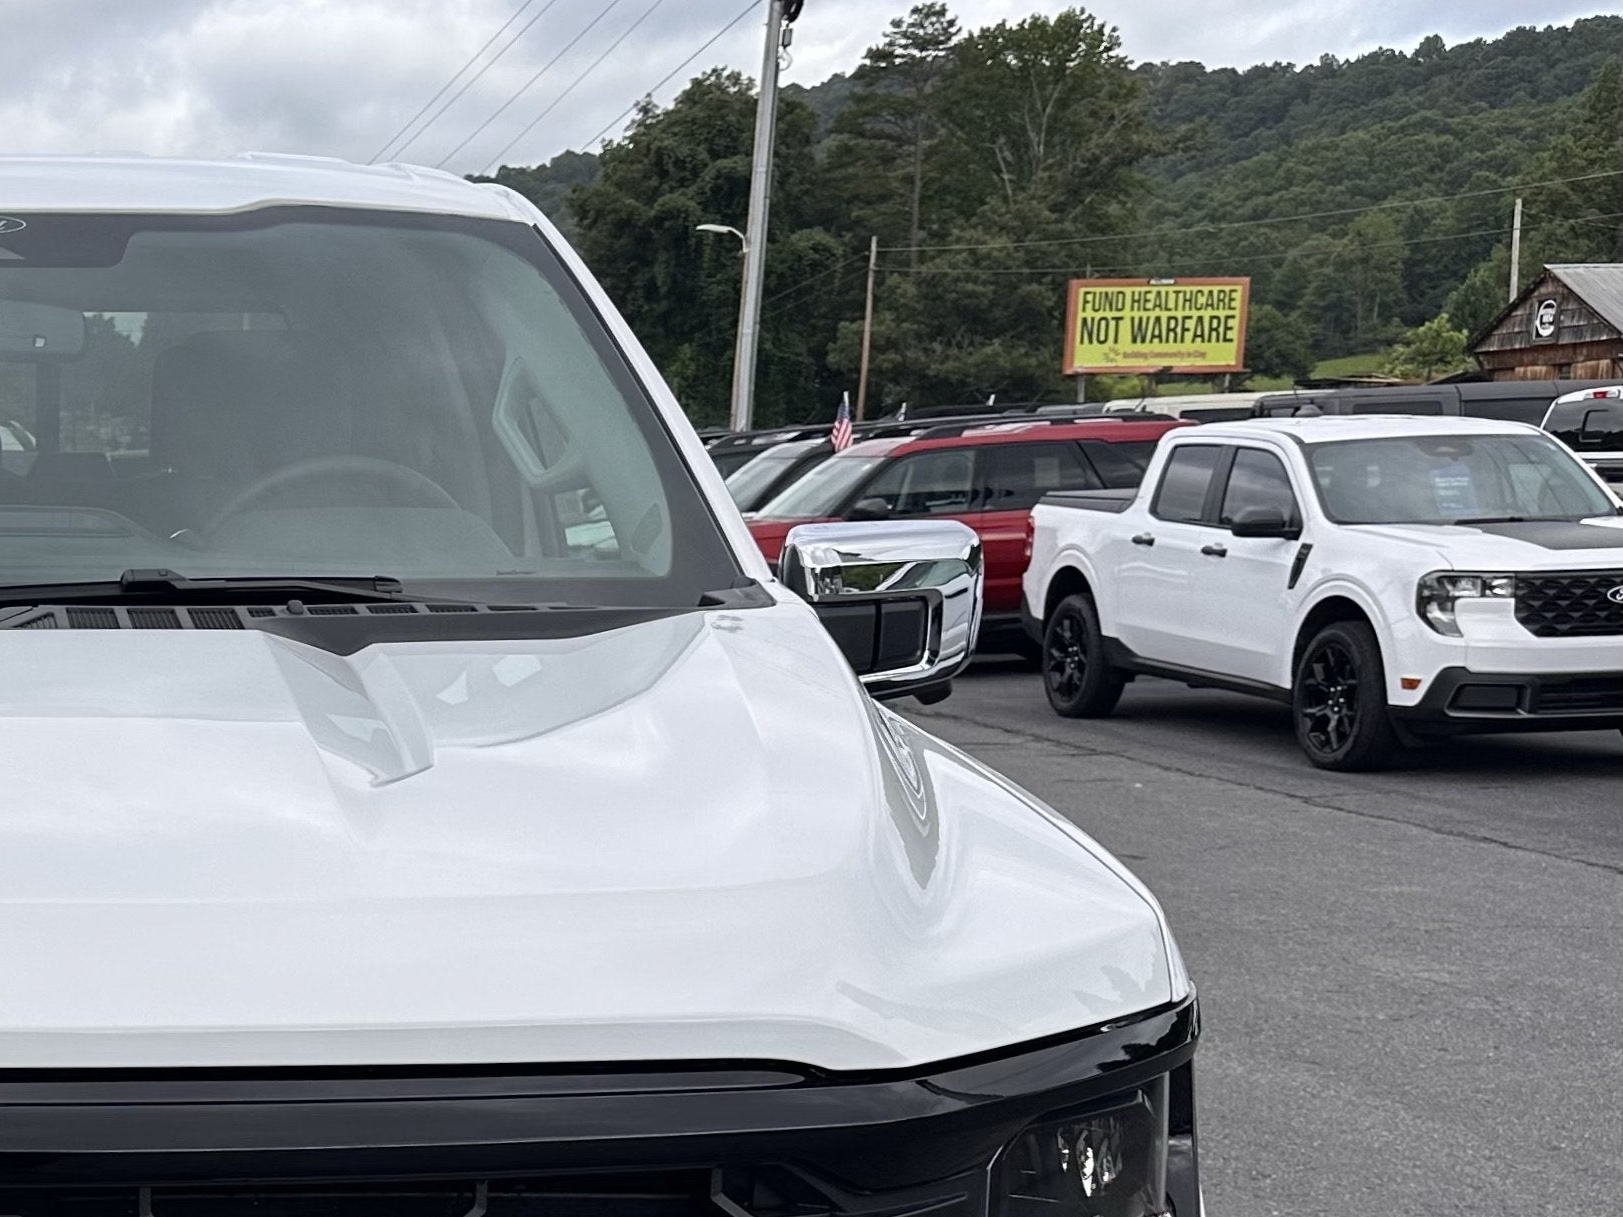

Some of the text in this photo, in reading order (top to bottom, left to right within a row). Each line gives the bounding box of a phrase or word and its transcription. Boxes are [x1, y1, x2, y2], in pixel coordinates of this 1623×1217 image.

[1082, 289, 1238, 313] FUND HEALTHCARE
[1079, 315, 1236, 345] NOT WARFARE
